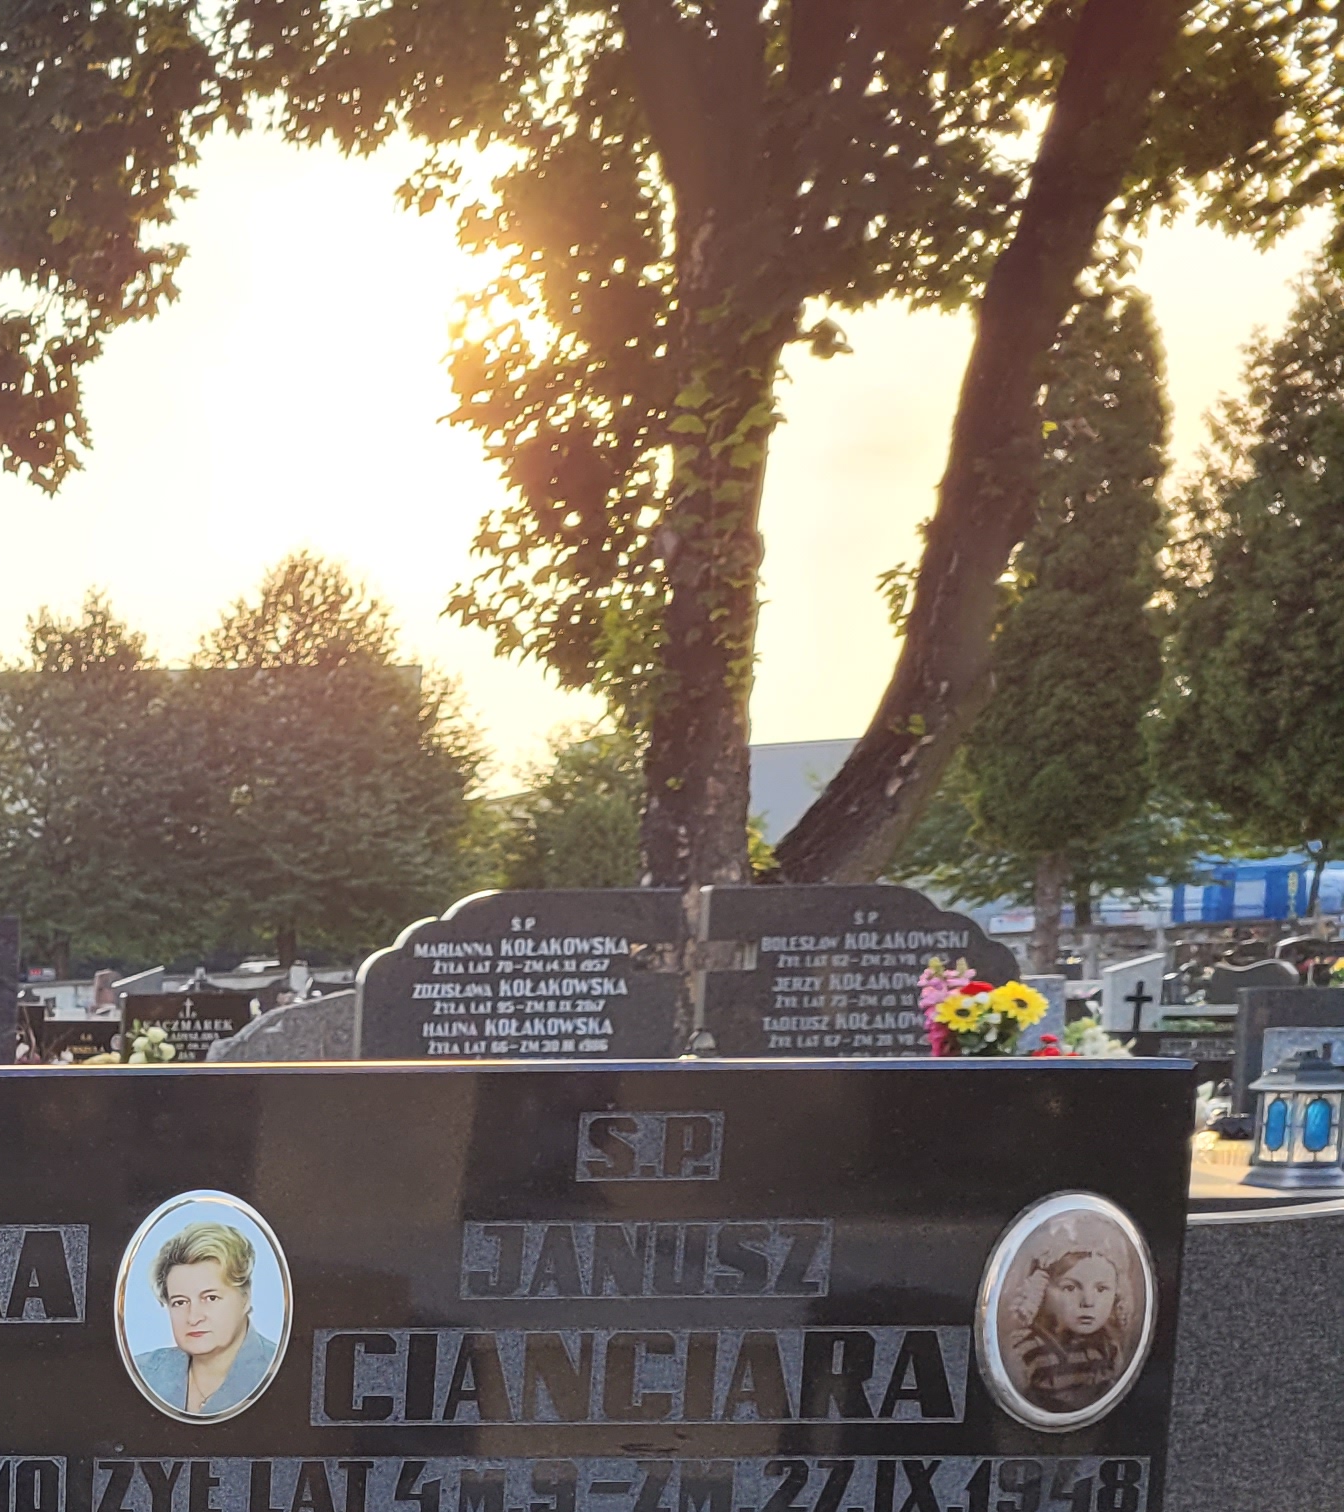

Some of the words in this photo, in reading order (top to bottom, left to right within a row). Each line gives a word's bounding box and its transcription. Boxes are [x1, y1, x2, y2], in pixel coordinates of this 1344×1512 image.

[413, 942, 493, 957] MARIANNA
[500, 937, 629, 956] KOŁAKOWSKA
[844, 930, 969, 950] KOŁAKOWSKI
[498, 977, 628, 997] KOŁAKOWSKA
[771, 977, 822, 992] JERZY
[828, 973, 918, 991] KOŁAKOW
[422, 1020, 478, 1037] HALINA
[484, 1017, 614, 1036] KOŁAKOWSKA
[763, 1015, 830, 1031] TADEUSZ
[834, 1011, 925, 1030] KOŁAKOW
[466, 1222, 825, 1298] JANUSZ
[324, 1328, 954, 1422] CIANCIARA
